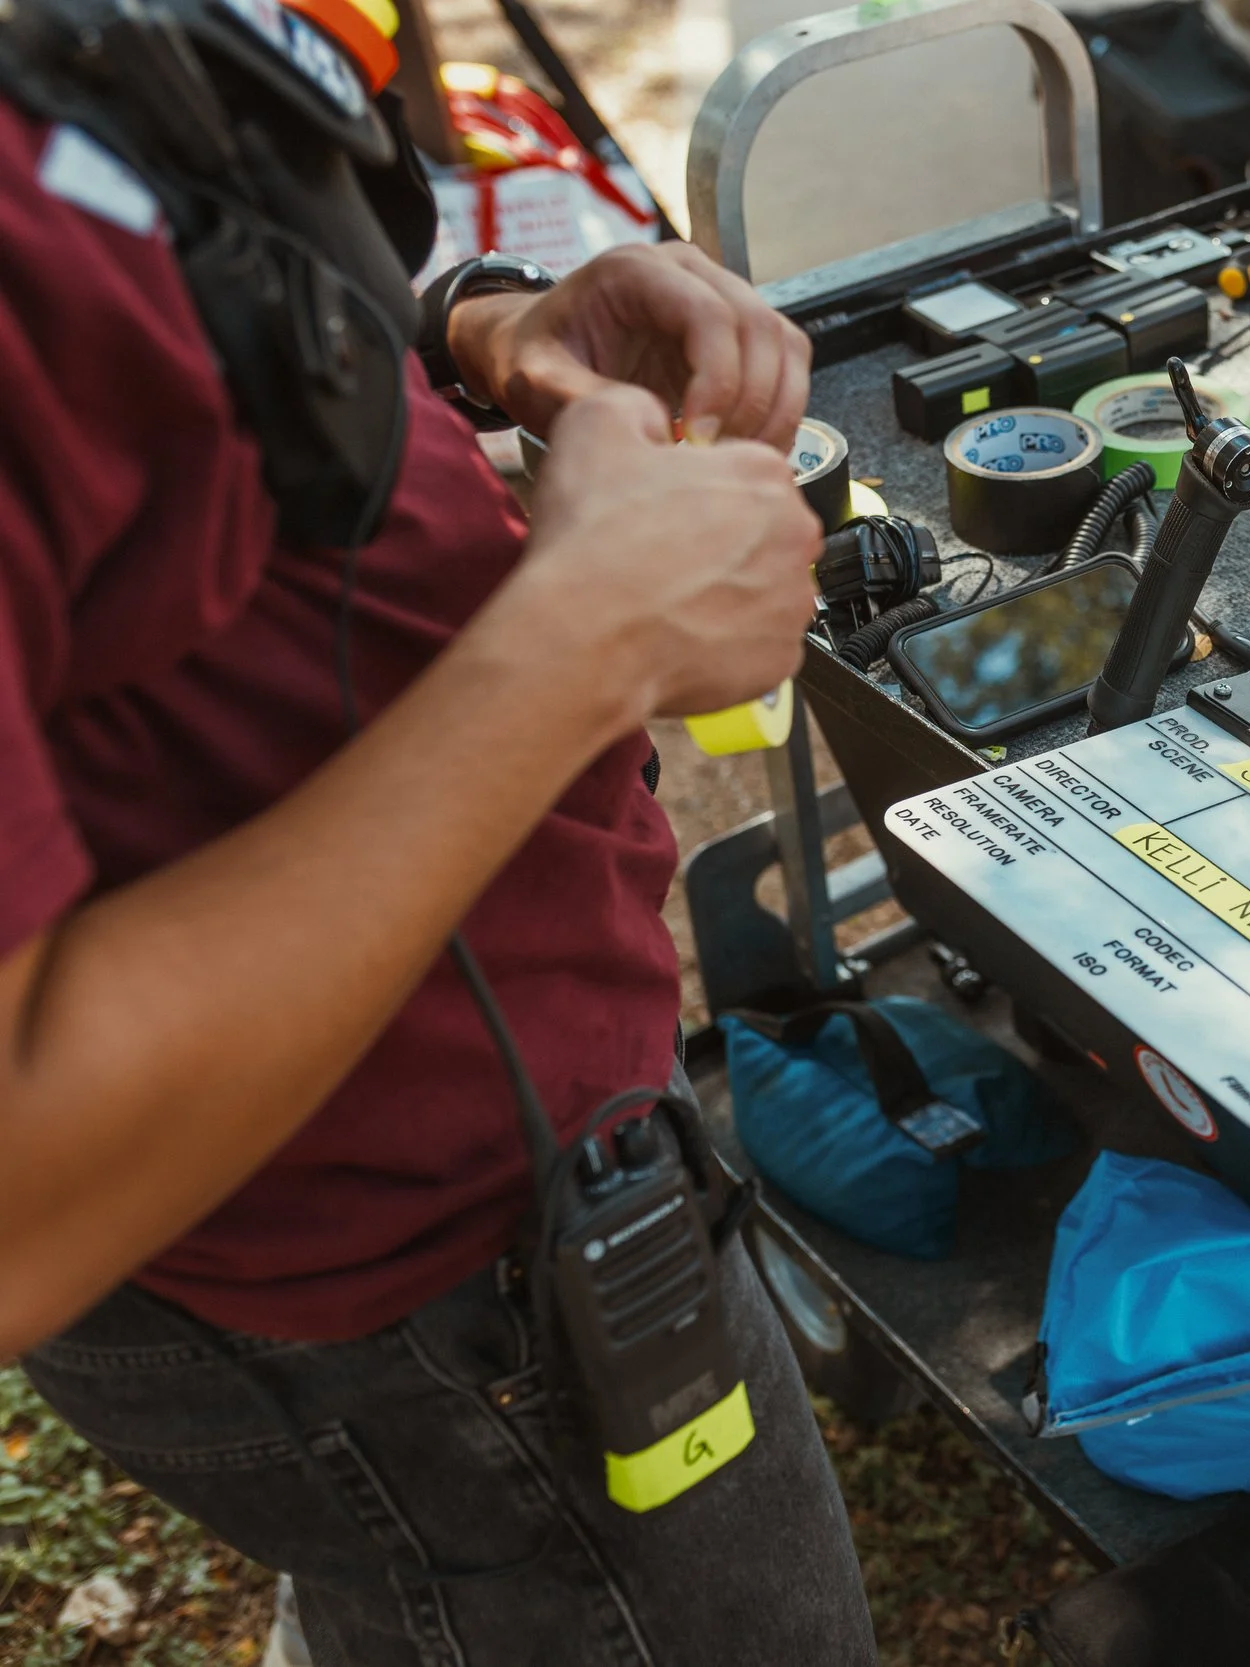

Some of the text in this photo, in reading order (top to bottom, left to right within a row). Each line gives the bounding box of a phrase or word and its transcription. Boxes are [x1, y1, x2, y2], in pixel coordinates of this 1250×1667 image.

[1020, 434, 1065, 453] PRO
[1158, 718, 1209, 754] PROD.
[1148, 740, 1214, 783] SCENE
[993, 774, 1065, 827] CAMERA
[1034, 759, 1121, 820] DIRECTOR
[894, 808, 941, 841] DATE
[923, 798, 1016, 866] RESOLUTION
[953, 779, 1047, 855] FRAMERATE
[1073, 952, 1108, 976] ISO
[1103, 939, 1178, 993] FORMAT
[1134, 928, 1195, 972] CODEC
[682, 1428, 715, 1467] G
